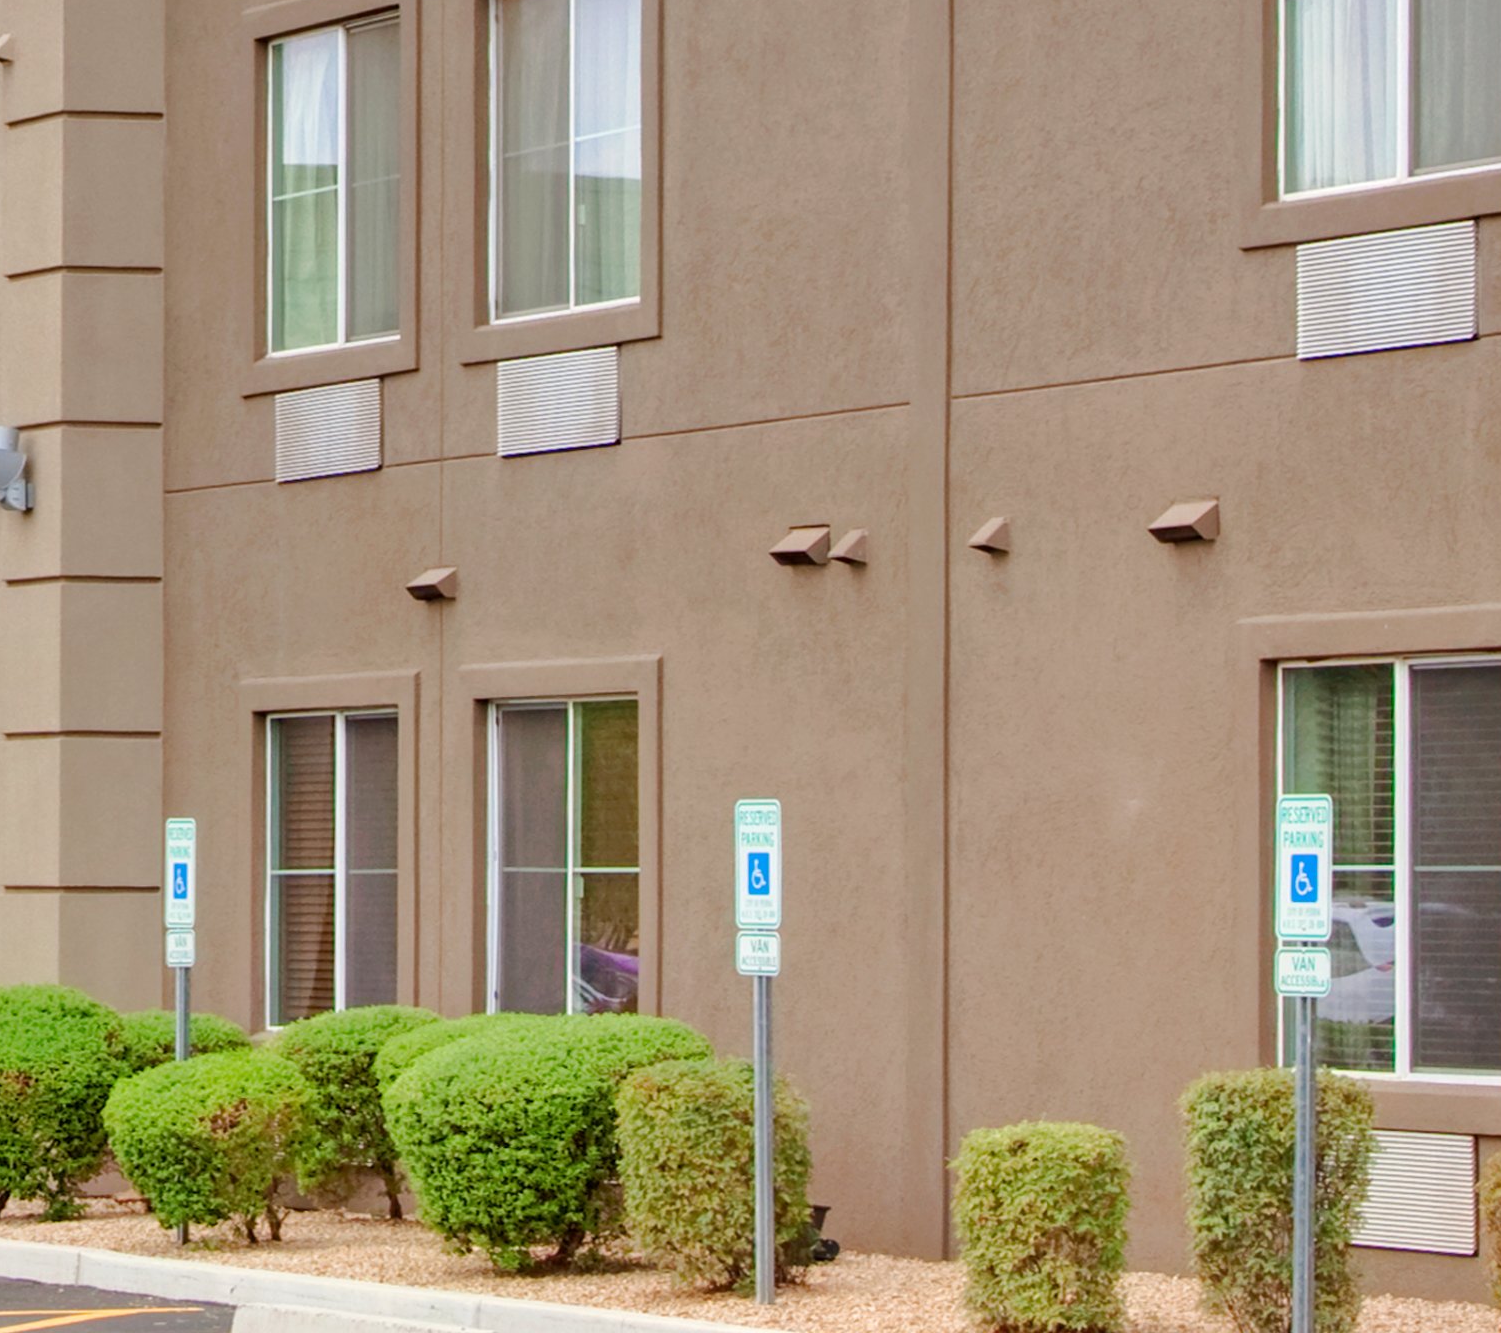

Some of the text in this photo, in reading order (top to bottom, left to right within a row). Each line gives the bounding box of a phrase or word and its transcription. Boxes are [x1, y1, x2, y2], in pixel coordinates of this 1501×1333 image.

[1280, 806, 1329, 824] RESERVED
[1283, 831, 1324, 849] PARKING
[750, 939, 770, 954] VAN
[1291, 955, 1316, 971] VAN
